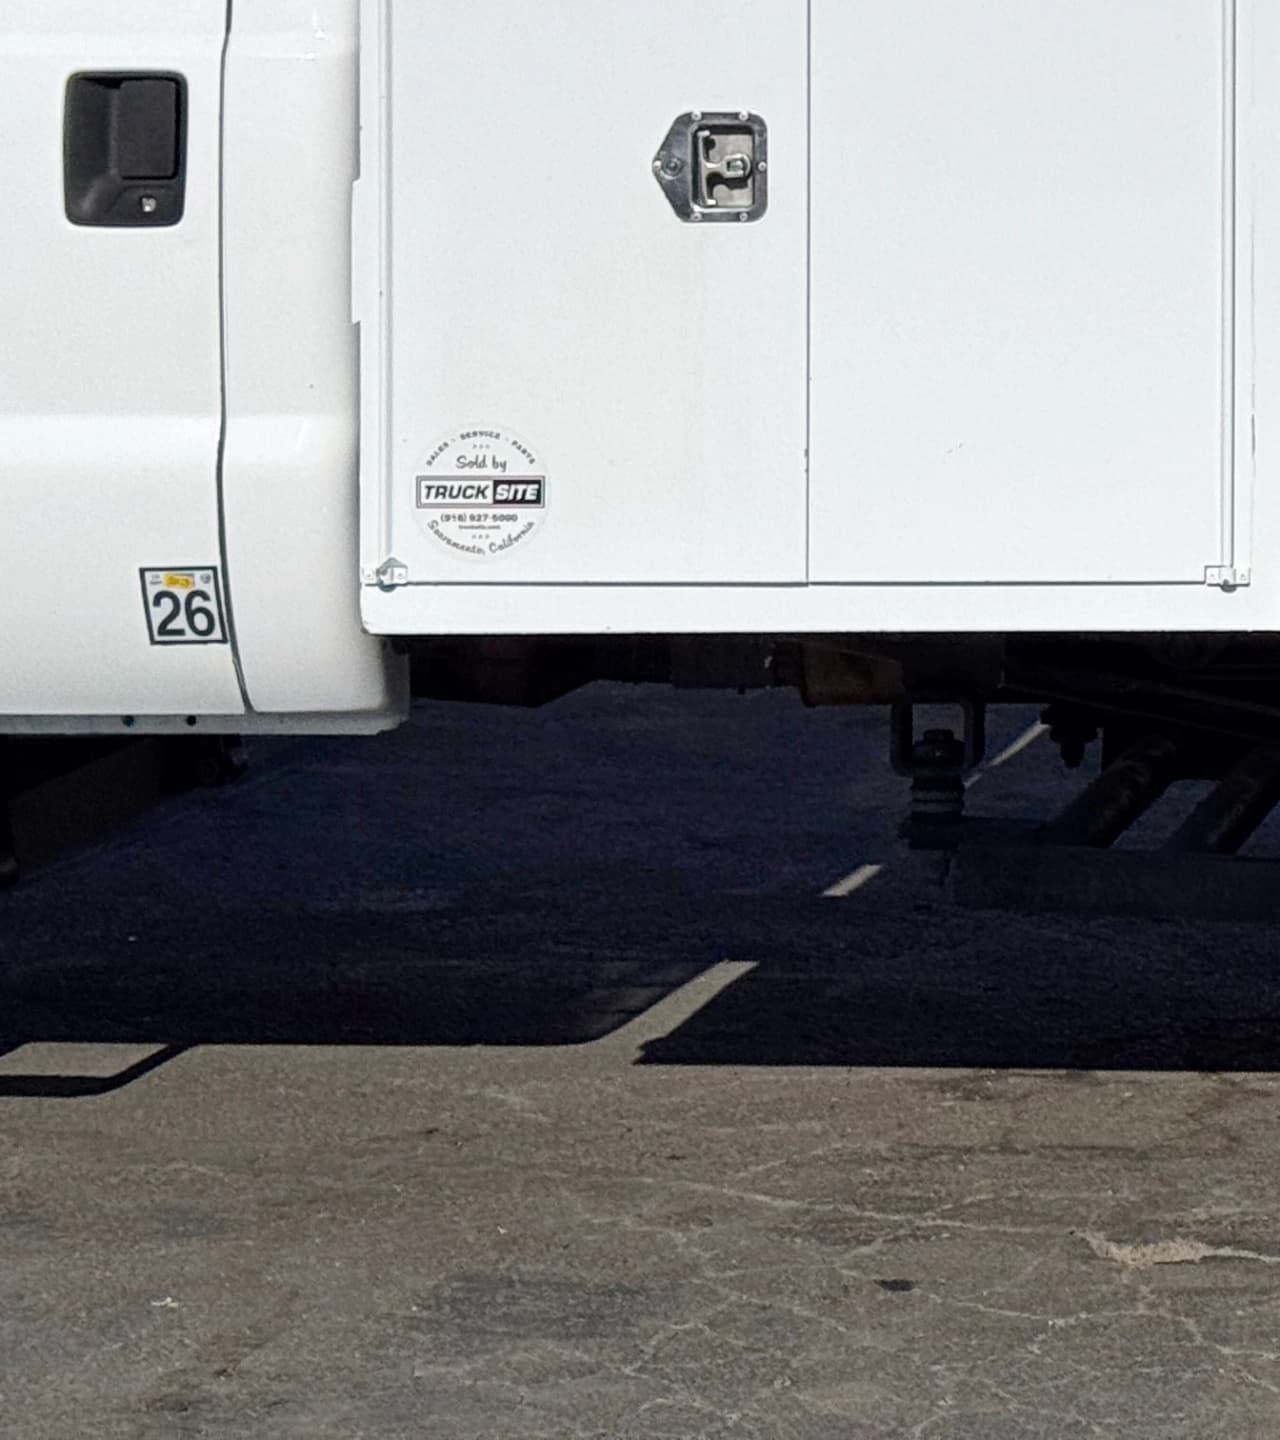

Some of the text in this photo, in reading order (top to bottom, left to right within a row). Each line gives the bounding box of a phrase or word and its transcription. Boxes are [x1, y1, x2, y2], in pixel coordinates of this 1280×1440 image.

[455, 454, 508, 473] Sold by
[424, 483, 540, 501] TRUCK SITE
[152, 589, 216, 637] 26
